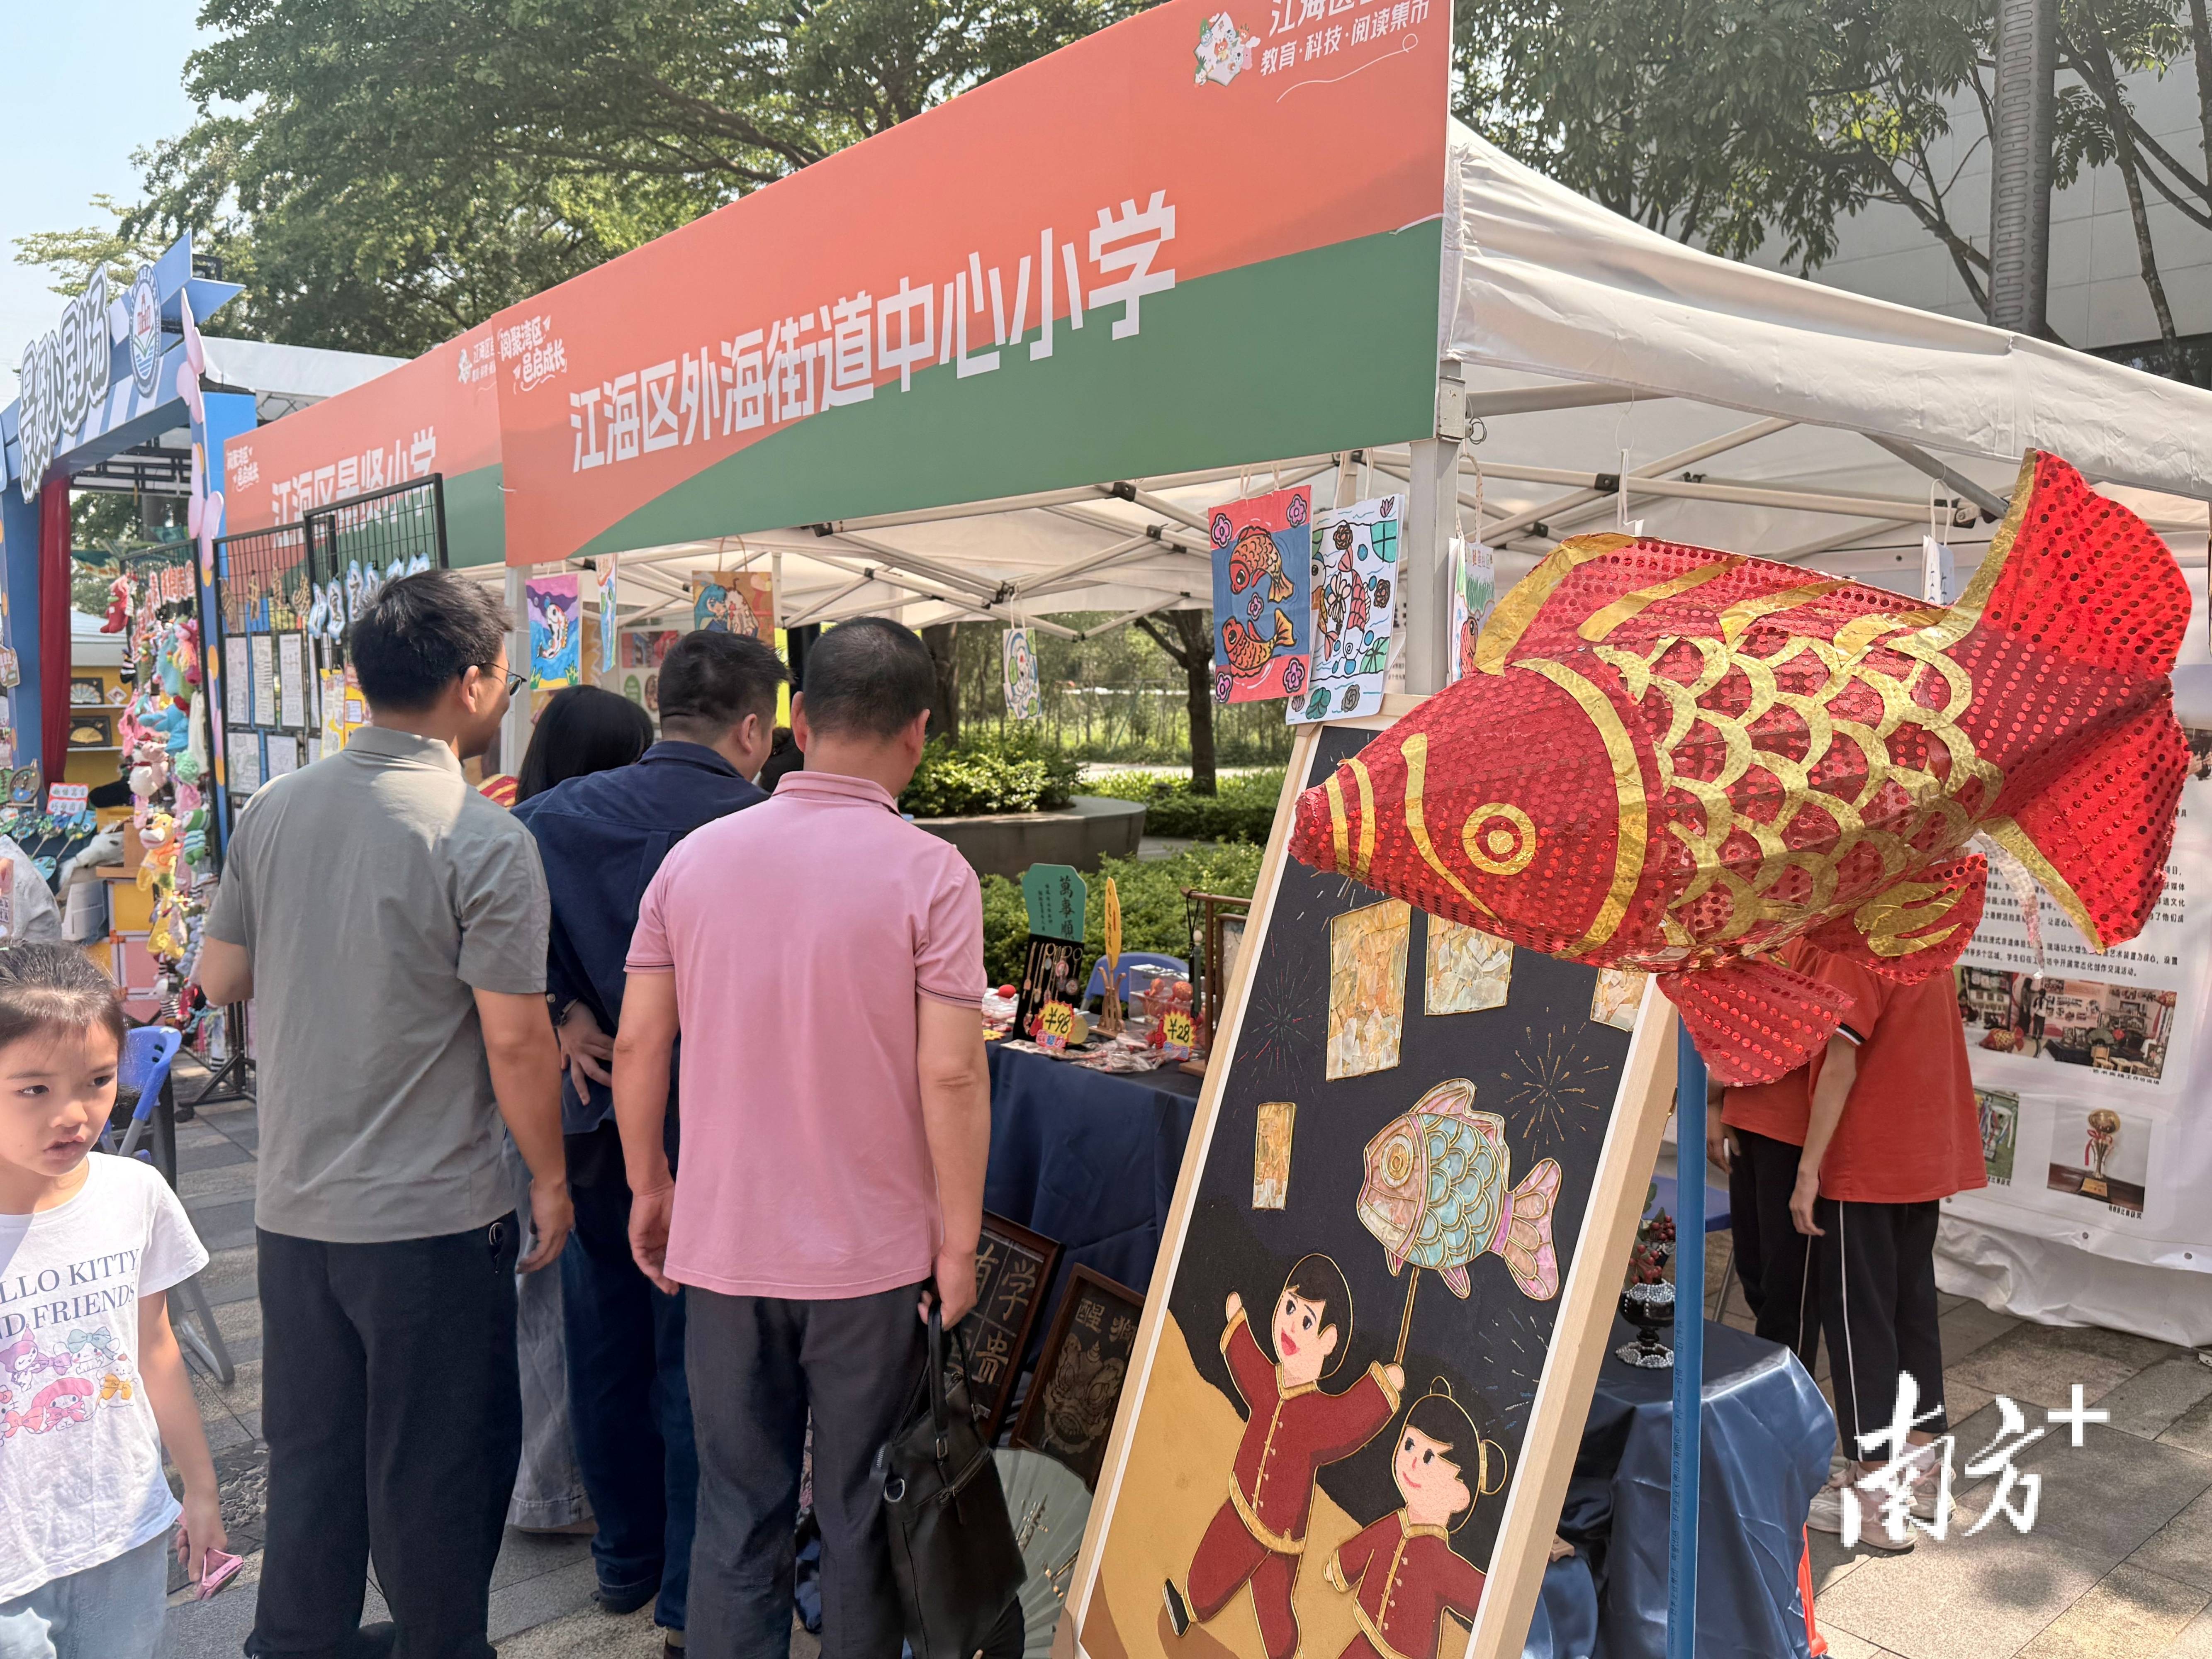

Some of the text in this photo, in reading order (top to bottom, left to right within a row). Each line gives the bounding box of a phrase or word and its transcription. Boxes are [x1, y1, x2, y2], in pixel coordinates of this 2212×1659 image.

[1269, 0, 1374, 37] 江海
[1260, 0, 1429, 76] 教育·科技·阅读集市
[570, 189, 1175, 473] 江海区外海街道中心小学
[1045, 1007, 1071, 1034] ¥98
[1167, 1018, 1190, 1043] ¥28
[67, 1248, 139, 1286] KITTY
[0, 1282, 134, 1340] D FRIENDS
